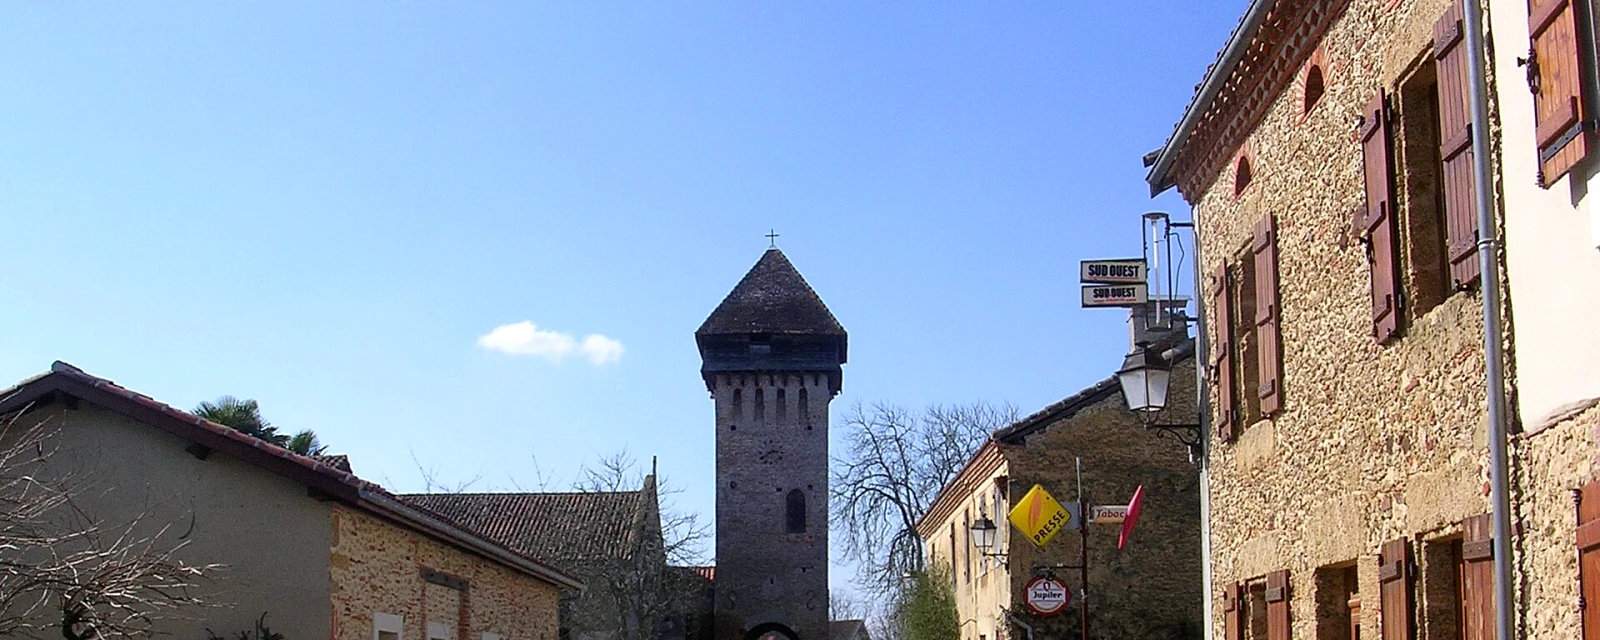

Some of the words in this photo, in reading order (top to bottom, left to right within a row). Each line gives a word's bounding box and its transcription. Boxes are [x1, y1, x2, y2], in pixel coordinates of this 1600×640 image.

[1088, 264, 1108, 277] SUD
[1109, 264, 1140, 277] OUEST
[1093, 288, 1110, 298] SUD
[1110, 287, 1136, 298] OUEST
[1096, 509, 1125, 518] Tabac
[1033, 510, 1066, 543] PRESSE
[1033, 591, 1063, 600] Jupiler
